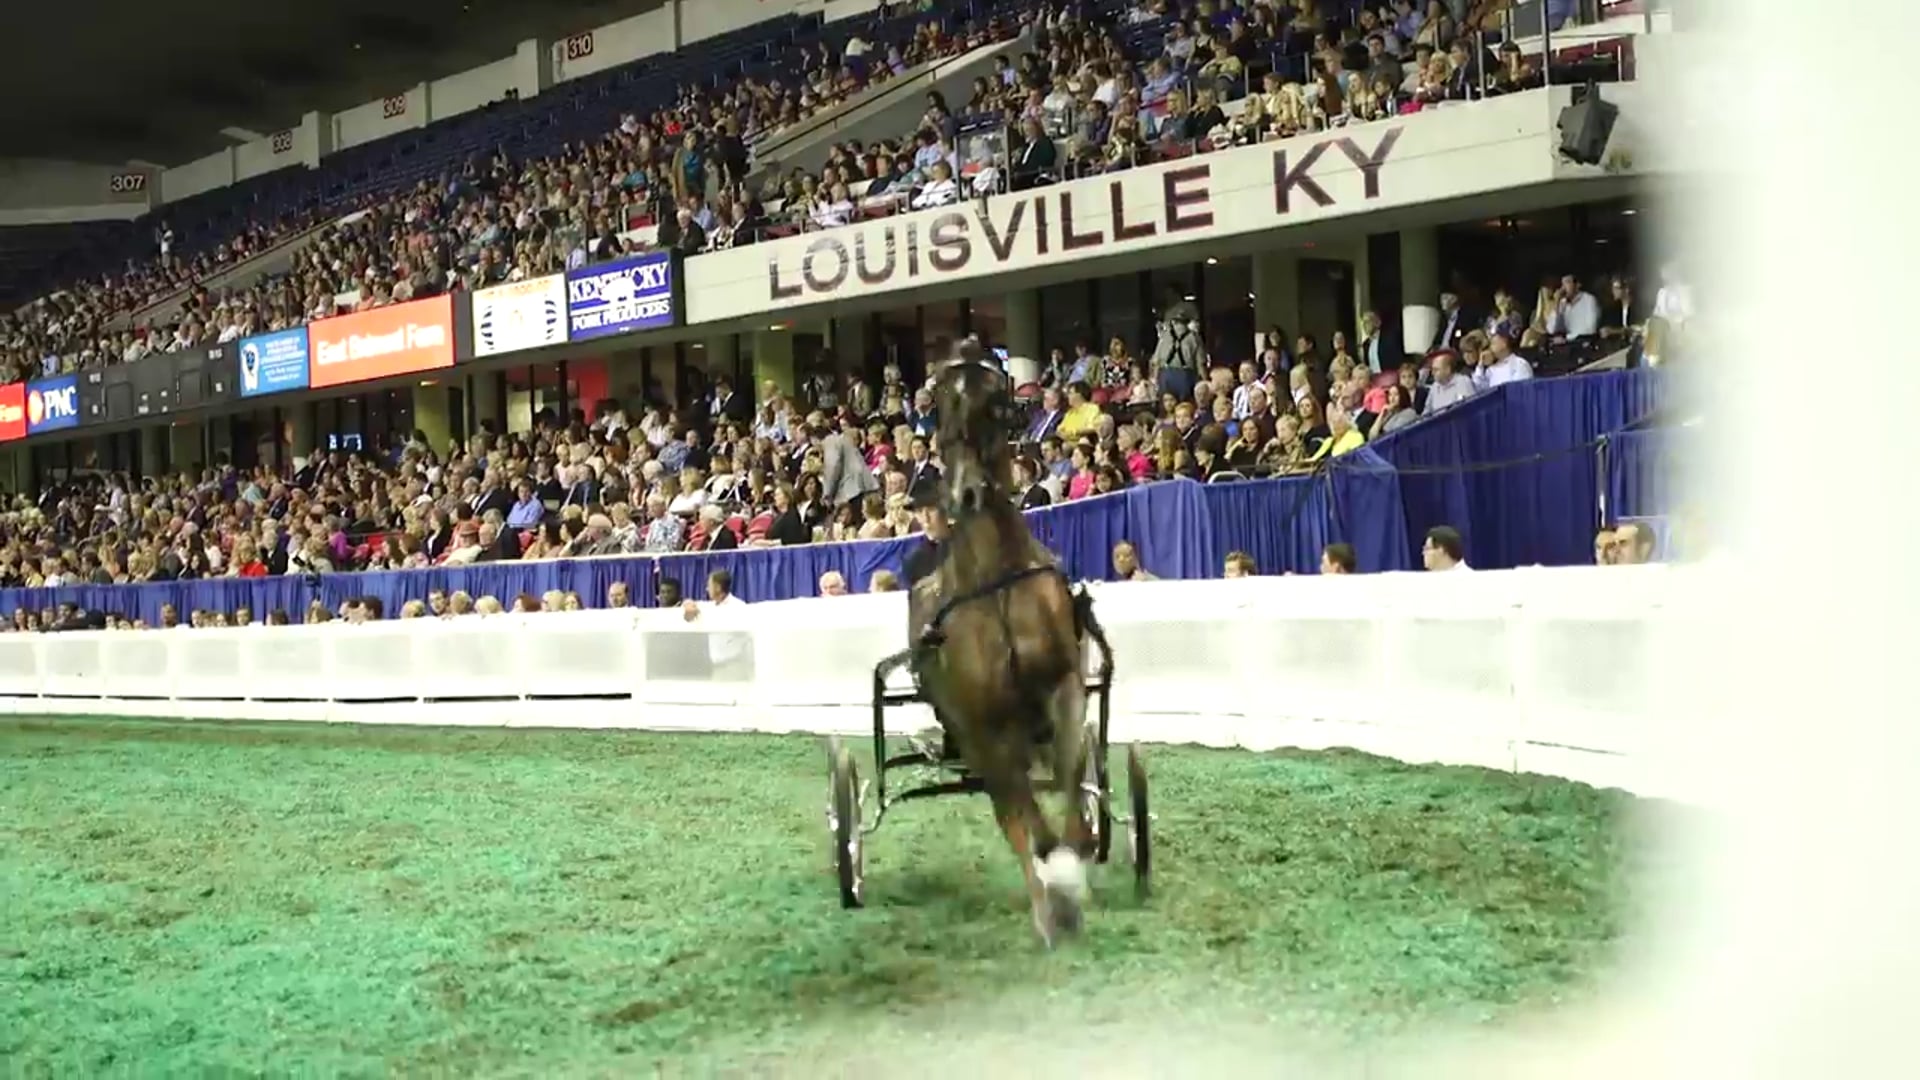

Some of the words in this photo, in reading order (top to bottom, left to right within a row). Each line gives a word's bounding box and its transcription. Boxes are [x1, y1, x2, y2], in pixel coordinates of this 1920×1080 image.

[569, 35, 592, 58] 310
[383, 96, 406, 117] 309
[111, 174, 144, 192] 307
[768, 163, 1214, 301] LOUISVILLE
[1273, 126, 1405, 214] KY
[572, 313, 604, 332] PORK
[604, 299, 670, 326] PRODUCERS
[43, 385, 77, 420] PNC
